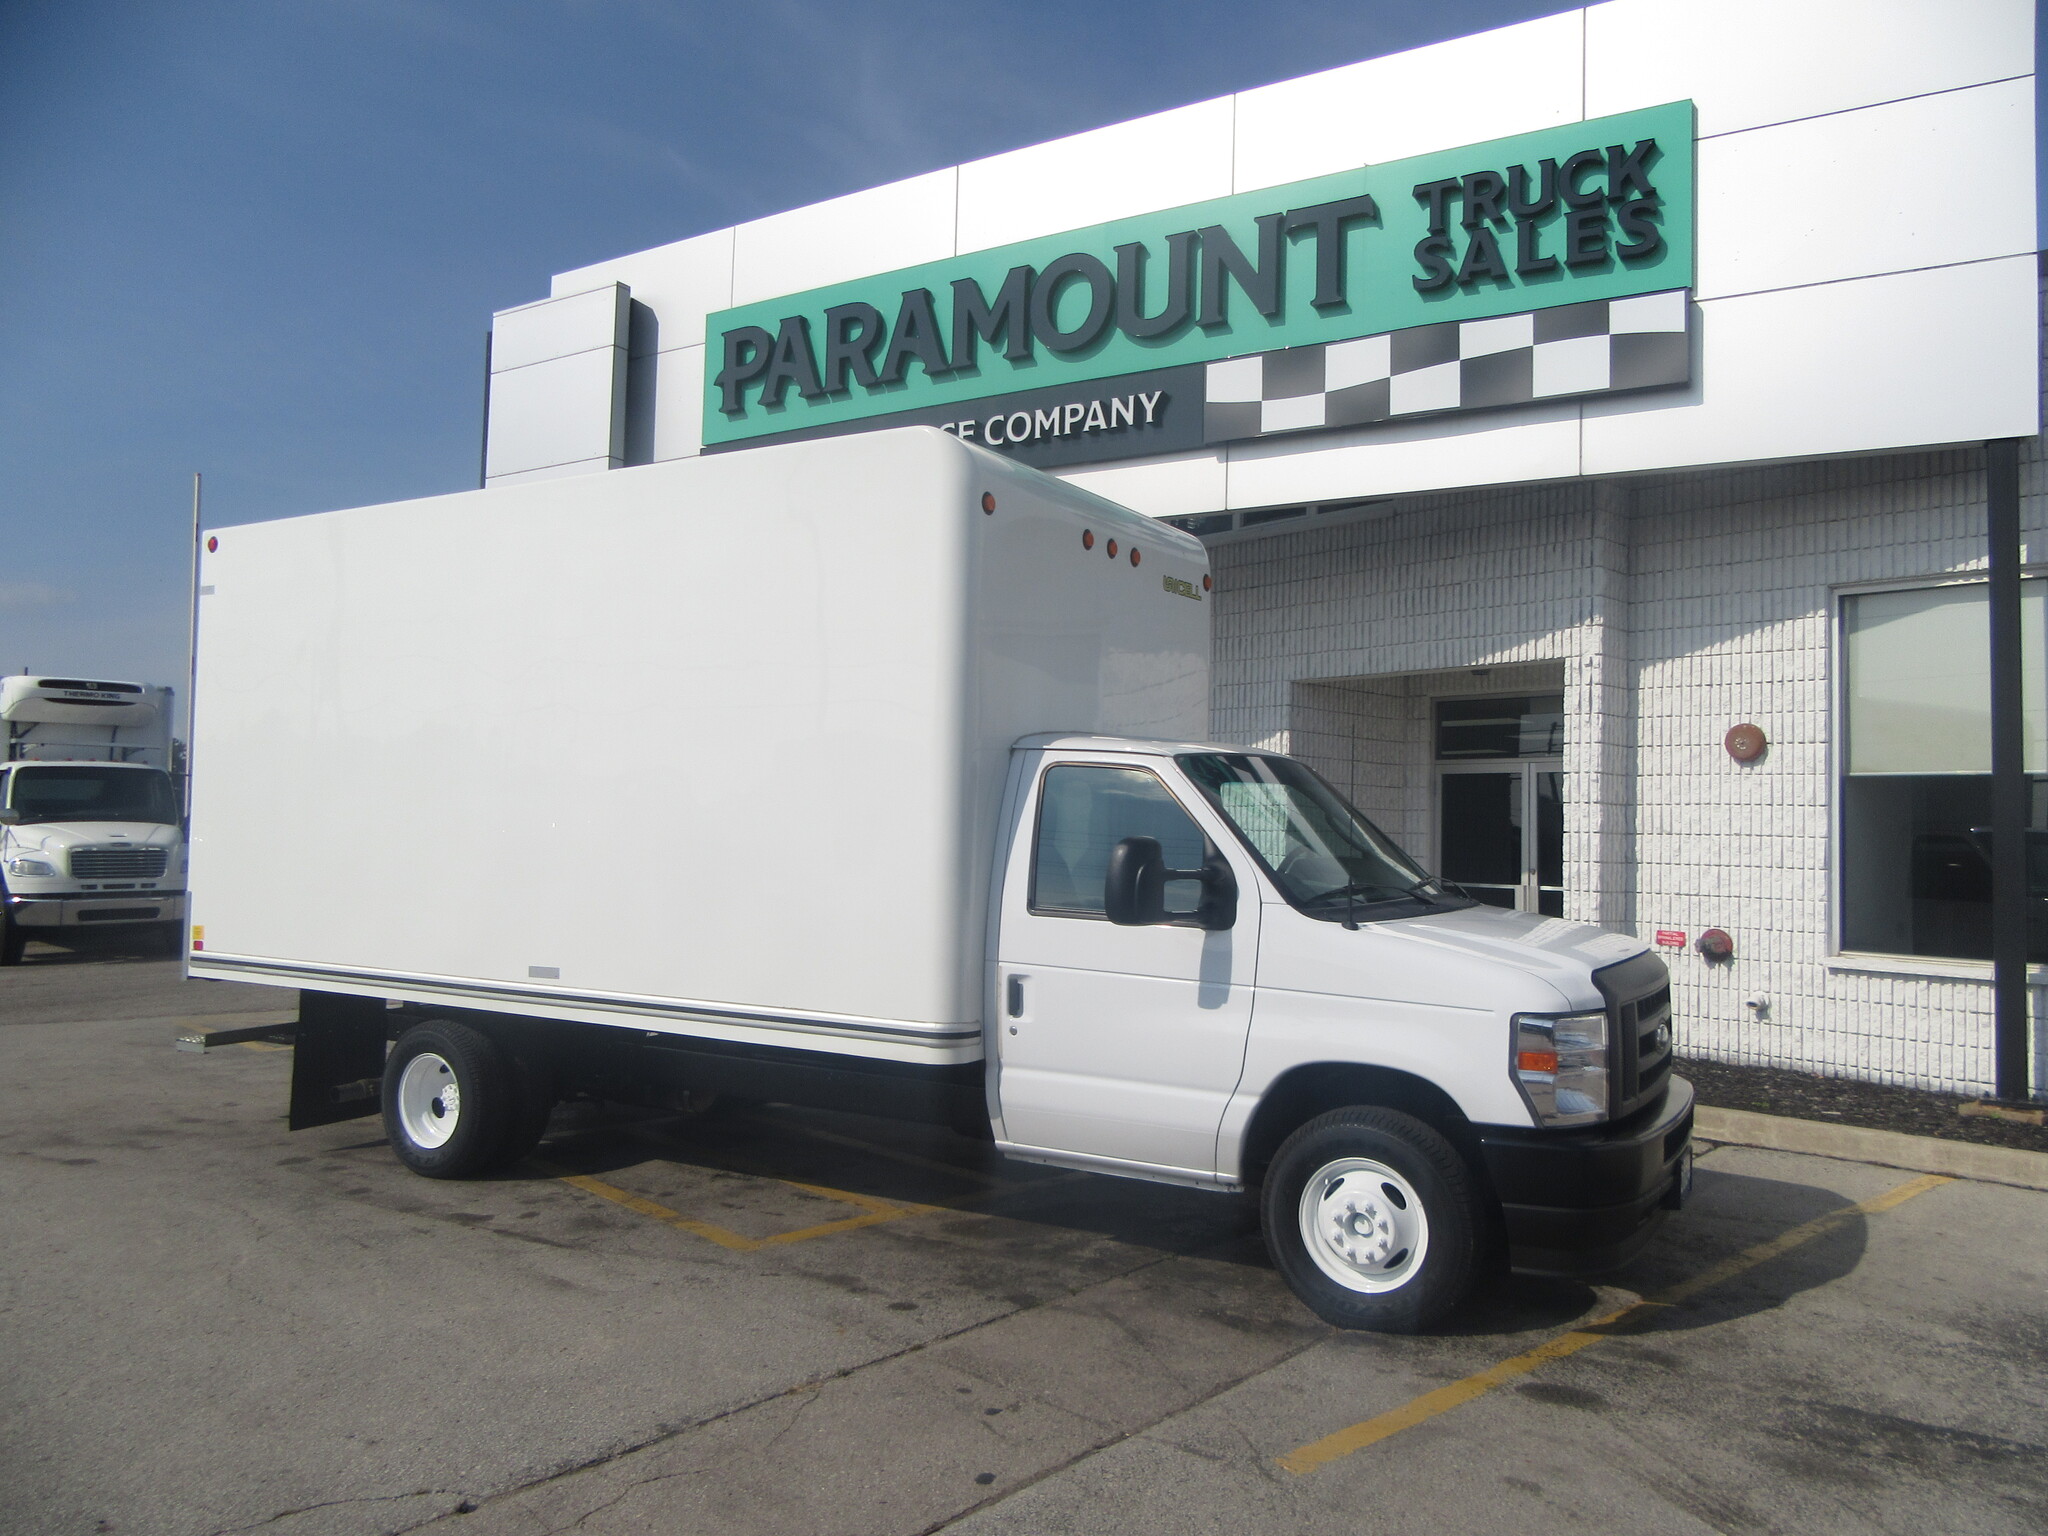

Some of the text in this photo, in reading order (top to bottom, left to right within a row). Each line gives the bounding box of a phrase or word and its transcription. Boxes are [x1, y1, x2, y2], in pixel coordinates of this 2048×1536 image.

[1411, 138, 1657, 236] TRUCK
[1411, 198, 1662, 292] SALES
[715, 193, 1378, 415] PARAMOUNT
[984, 390, 1164, 446] COMPANY
